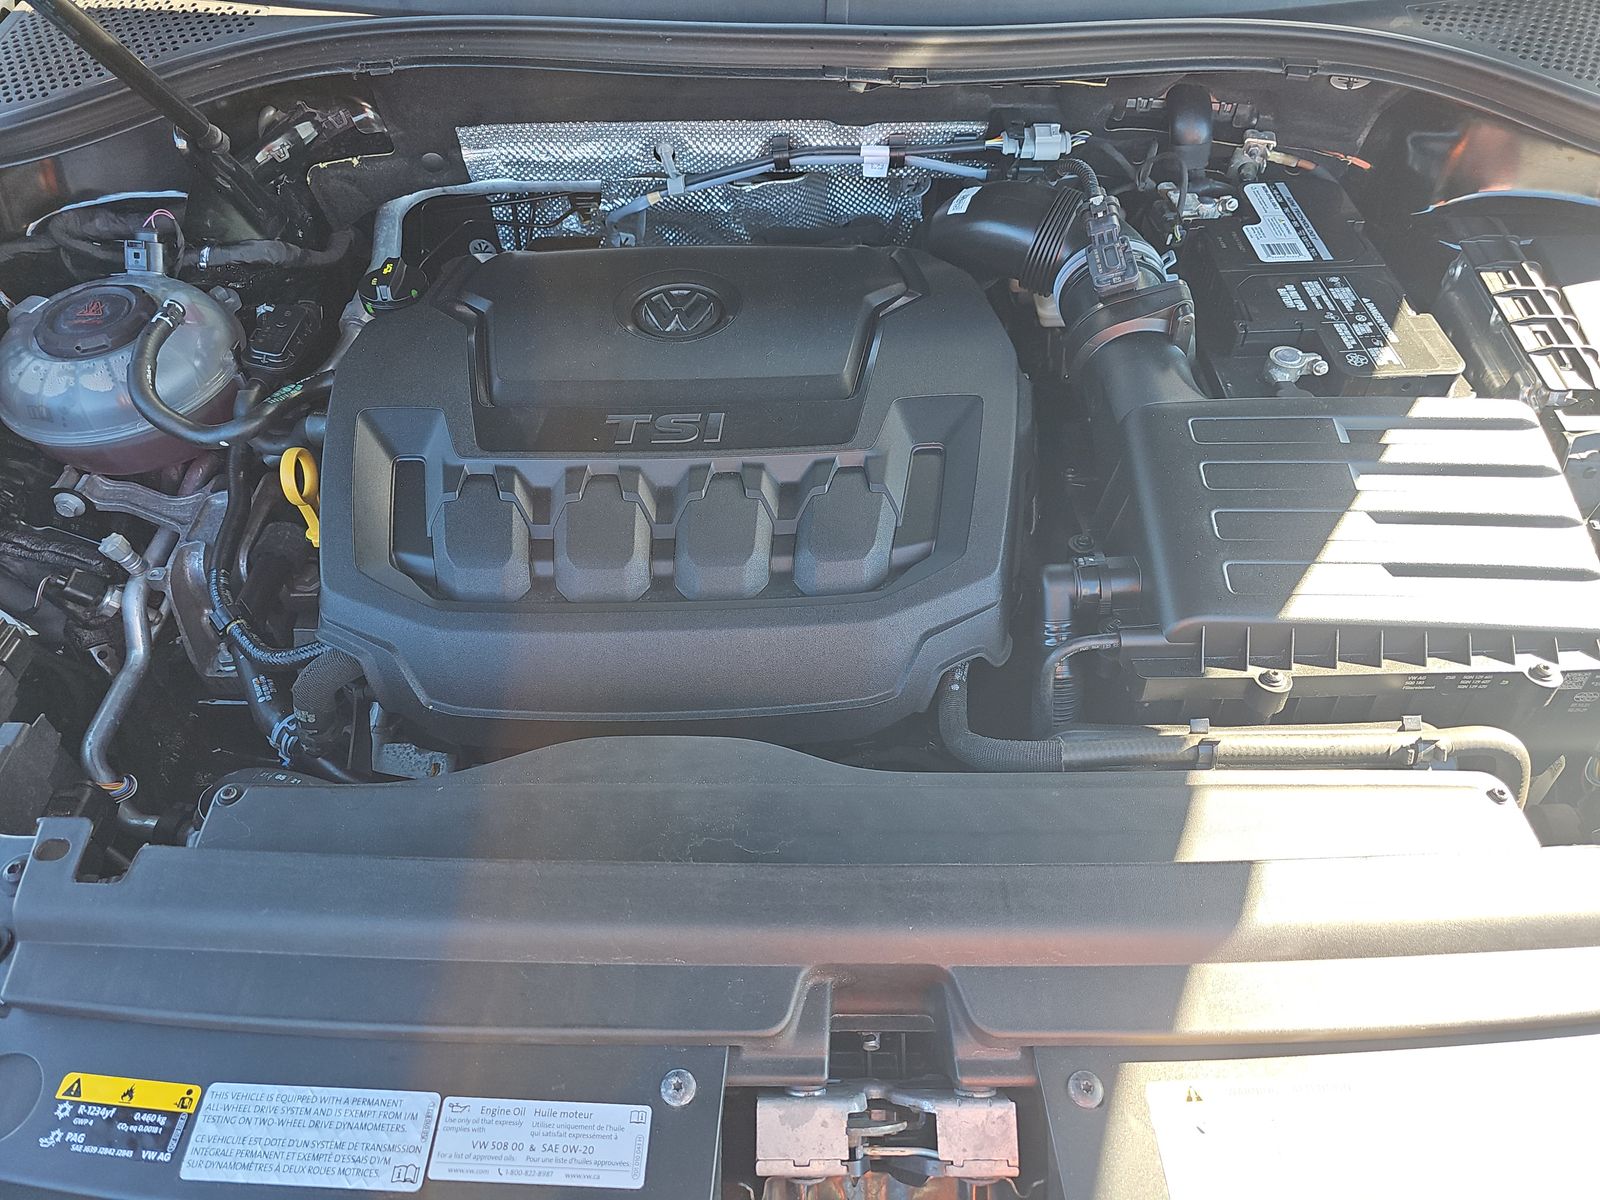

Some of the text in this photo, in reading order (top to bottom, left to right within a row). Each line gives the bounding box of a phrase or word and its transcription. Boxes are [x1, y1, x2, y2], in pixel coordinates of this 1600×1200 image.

[605, 412, 726, 444] TSI
[210, 1090, 404, 1108] THIS VEHICLE IS EQUIPPED WITH A PERMANENT
[77, 1104, 118, 1120] R-1234yf
[205, 1102, 419, 1121] ALL-WHEEL DRIVE SYSTEM AND IS EXEMPT FROM I/M
[480, 1105, 526, 1118] Engine Oil
[533, 1107, 594, 1120] Huile moteur
[72, 1117, 88, 1125] GWP
[133, 1111, 168, 1126] 0.460 kg
[201, 1114, 407, 1133] TESTING ON TWO-WHEEL DRIVE DYNAMOMETERS.
[457, 1117, 471, 1125] only
[494, 1119, 524, 1128] expressly
[442, 1125, 470, 1133] complies
[531, 1121, 556, 1129] Utilisez
[556, 1123, 596, 1132] uniquement
[605, 1124, 626, 1132] l'huile
[65, 1131, 86, 1144] PAG
[530, 1130, 541, 1138] qui
[541, 1130, 567, 1138] satisfait
[195, 1134, 208, 1143] CE
[248, 1136, 263, 1146] EST
[287, 1138, 309, 1149] D'UN
[347, 1141, 359, 1151] DE
[360, 1142, 422, 1154] TRANSMISSION
[471, 1140, 595, 1155] VW 508 00 & SAE 0W-20
[141, 1150, 172, 1162] VW AG
[234, 1148, 285, 1160] PERMANENT
[286, 1151, 296, 1160] ET
[296, 1152, 333, 1162] EXEMPTÉ
[333, 1154, 369, 1164] D'ESSAIS
[453, 1151, 464, 1159] list
[464, 1151, 472, 1159] of
[472, 1153, 503, 1162] approved
[526, 1155, 540, 1163] Pour
[554, 1156, 567, 1164] liste
[186, 1160, 204, 1169] SUR
[204, 1160, 273, 1173] DYNAMOMÈTRES
[282, 1164, 307, 1174] DEUX
[307, 1166, 335, 1175] ROUES
[337, 1168, 380, 1178] MOTRICES.
